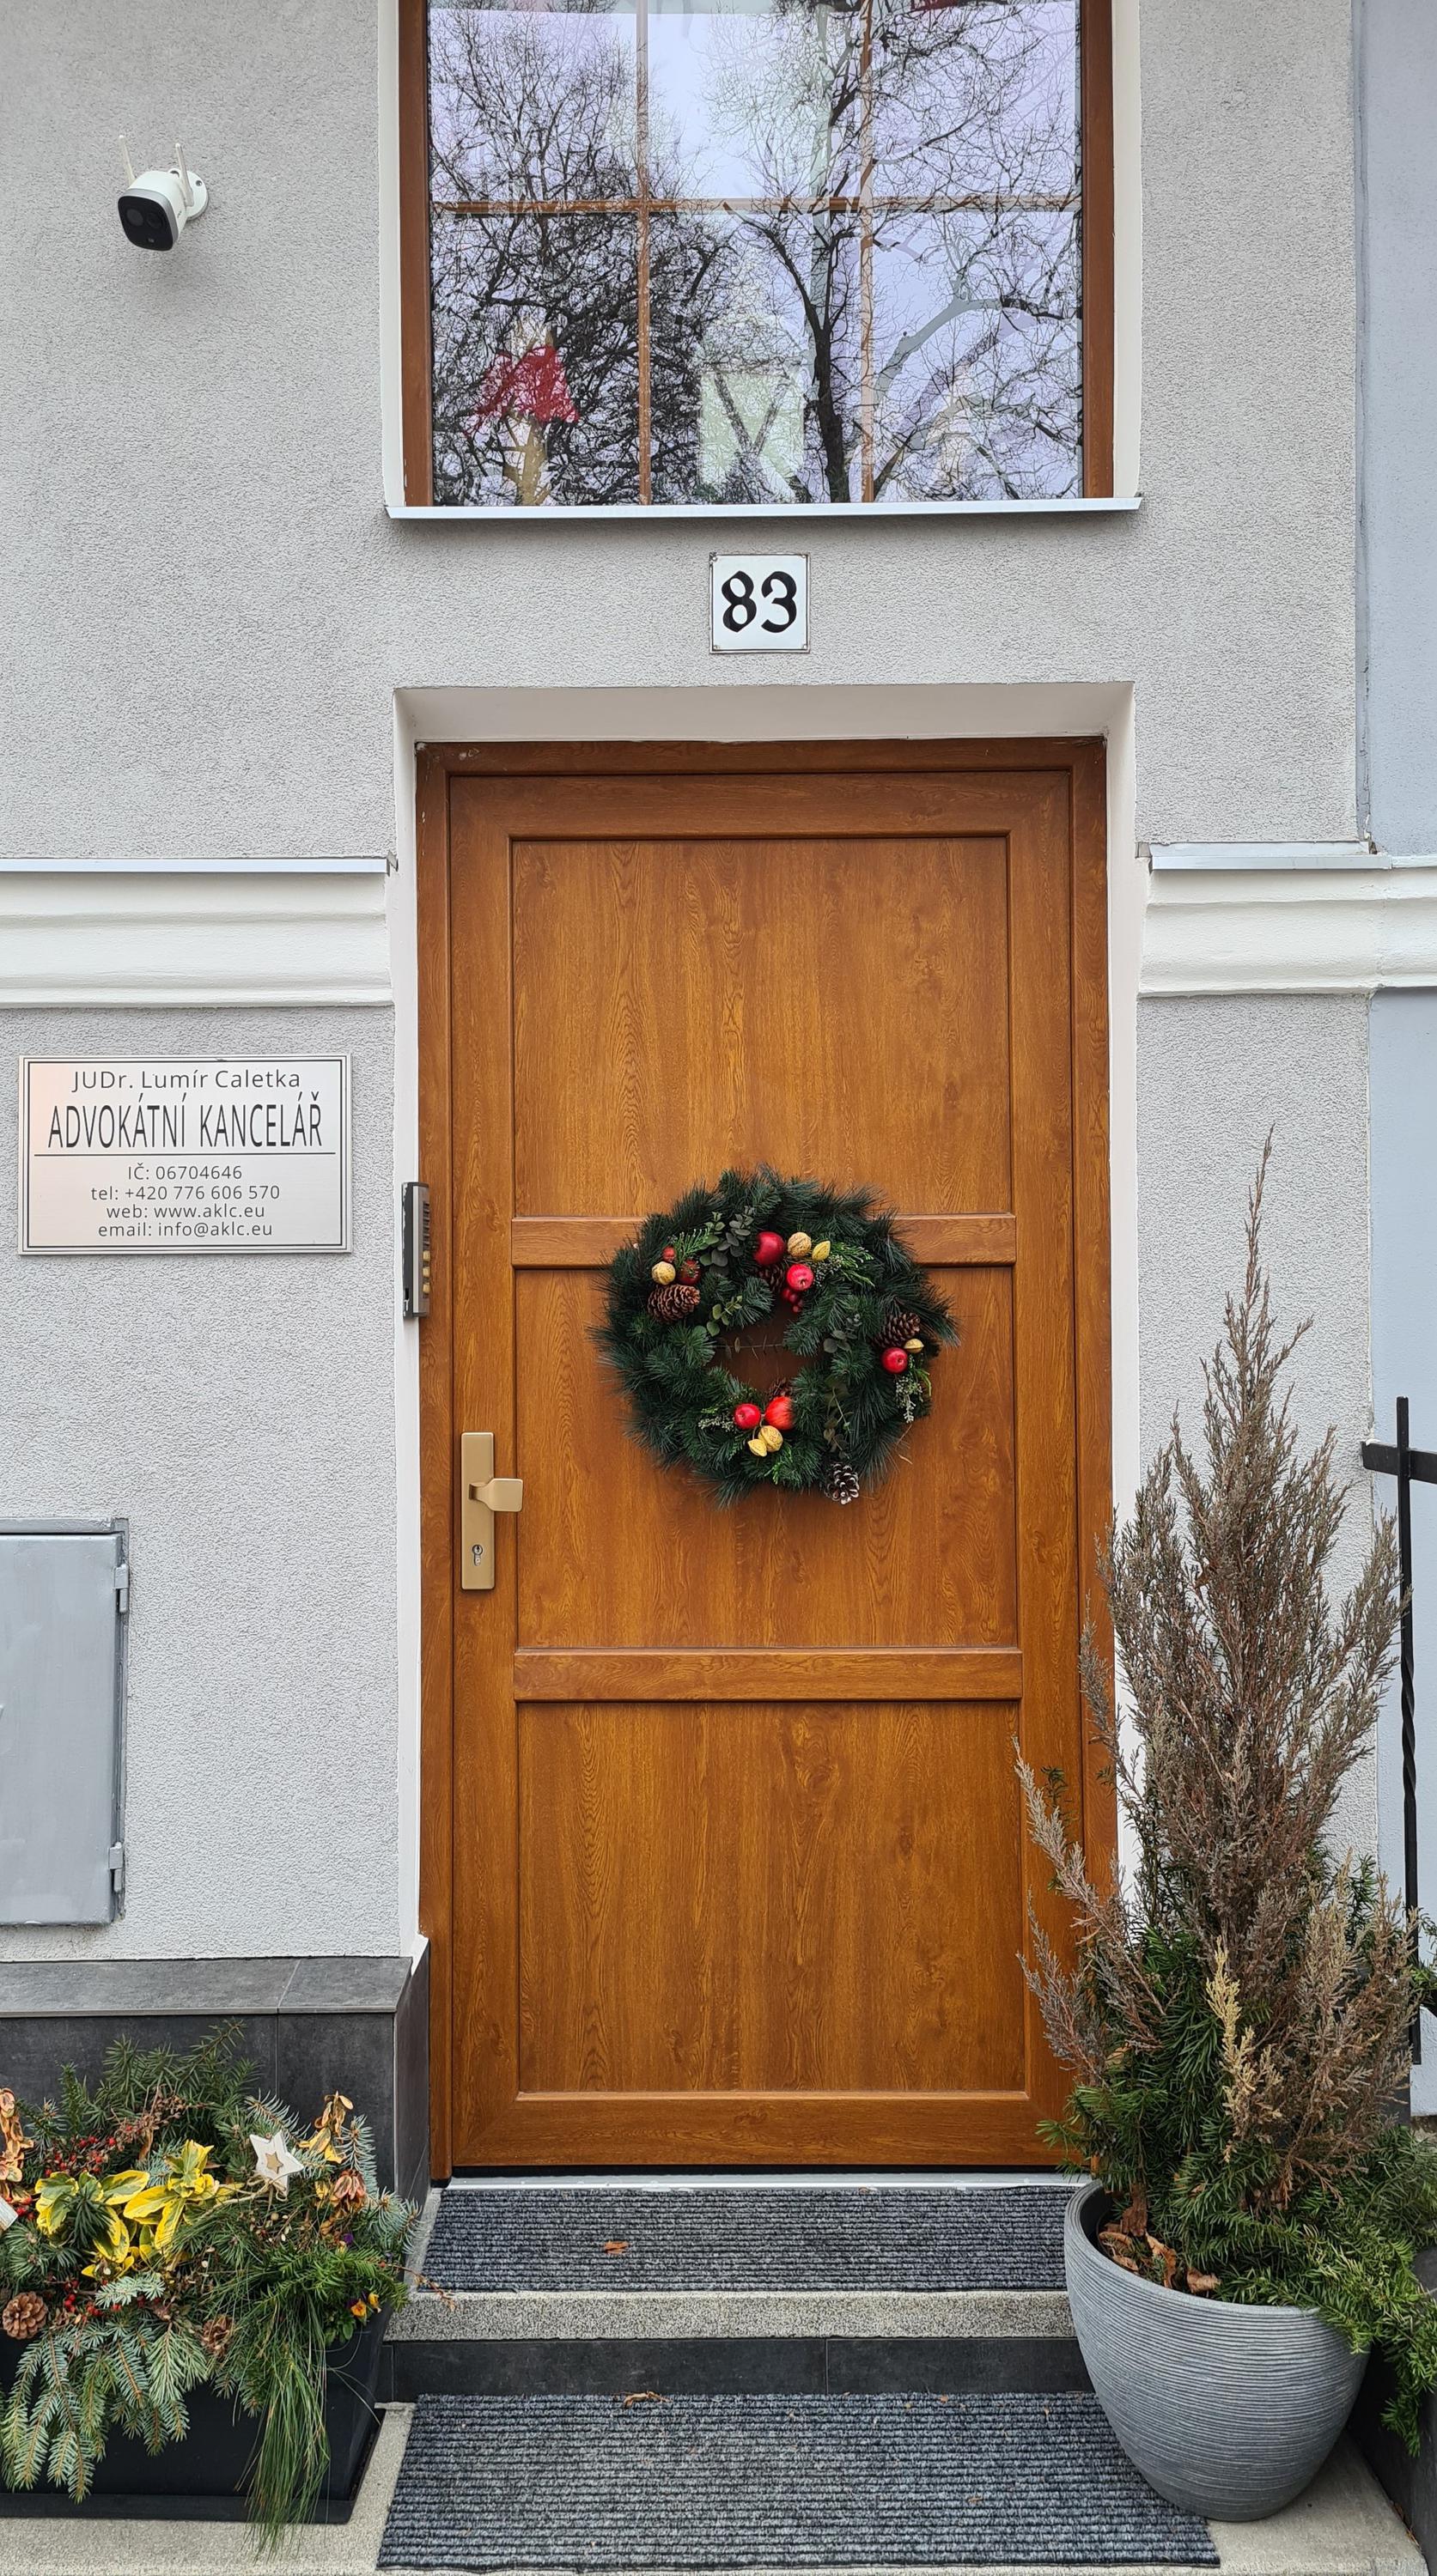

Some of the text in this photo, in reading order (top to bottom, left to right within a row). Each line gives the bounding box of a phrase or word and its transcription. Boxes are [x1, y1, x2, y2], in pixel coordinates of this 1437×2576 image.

[722, 570, 797, 634] 83
[72, 1069, 301, 1093] JUDr. Lumír Caletka
[48, 1091, 322, 1148] ADVOKÁTNÍ KANCELÁŘ
[128, 1163, 242, 1180] IČ: 06704646
[91, 1185, 280, 1200] tel: +420 776 606 570
[106, 1203, 265, 1218] web: www.aklc.eu
[98, 1222, 272, 1237] email: info@aklc.eu
